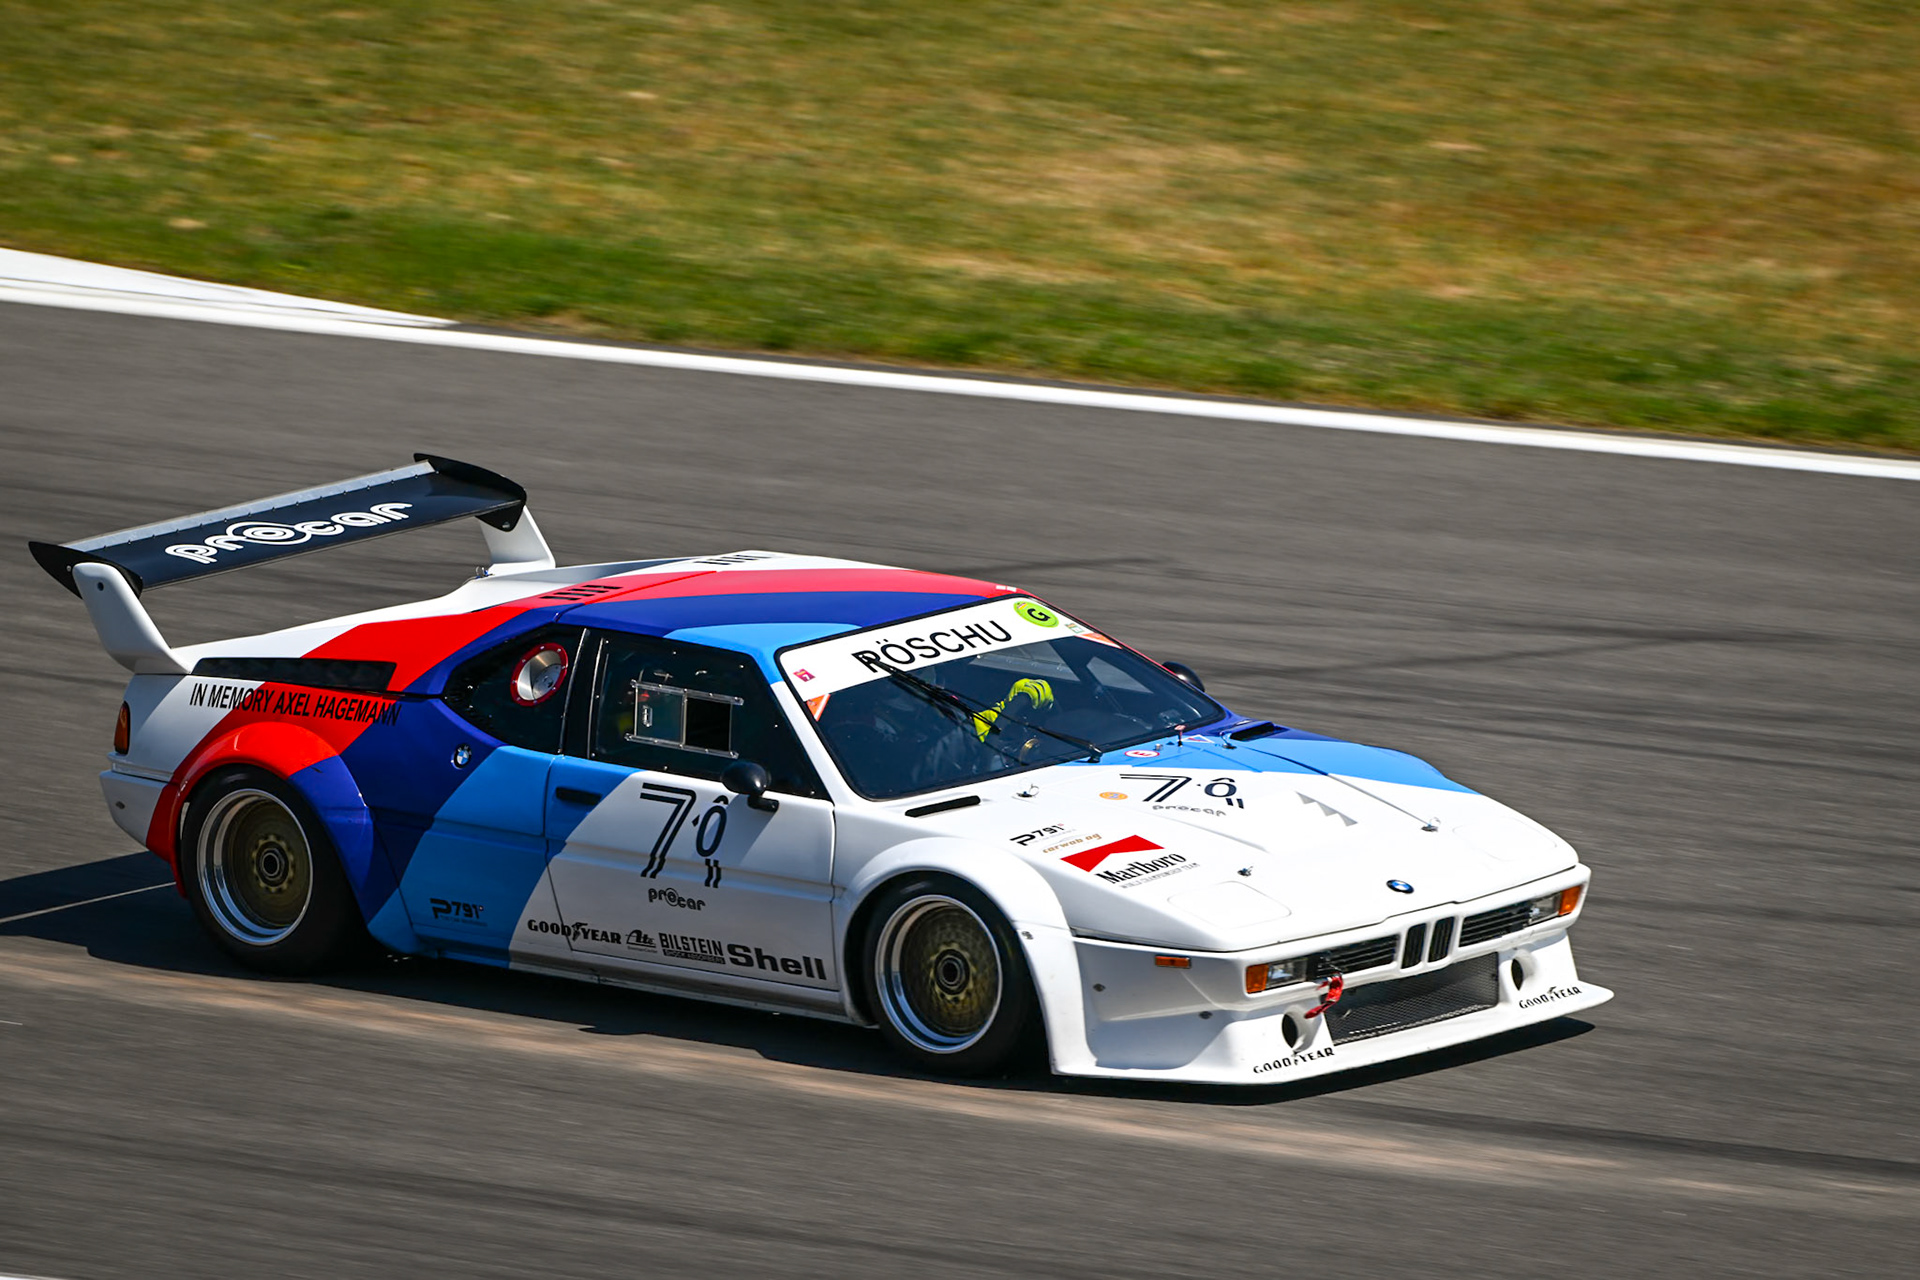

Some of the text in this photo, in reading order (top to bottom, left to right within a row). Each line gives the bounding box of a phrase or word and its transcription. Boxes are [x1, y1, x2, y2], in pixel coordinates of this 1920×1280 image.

[165, 502, 413, 564] procar
[1027, 608, 1051, 622] G
[851, 620, 1012, 673] RÖSCHU
[189, 682, 402, 727] IN MEMORY AXEL HAGEMANN
[1095, 853, 1187, 884] Marlboro
[648, 887, 706, 911] procar
[527, 919, 622, 945] GOODYEAR
[658, 932, 724, 956] BILSTEIN
[727, 943, 827, 981] Shell
[1518, 986, 1583, 1009] GOODYEAR
[1253, 1047, 1335, 1074] GOODYEAR
